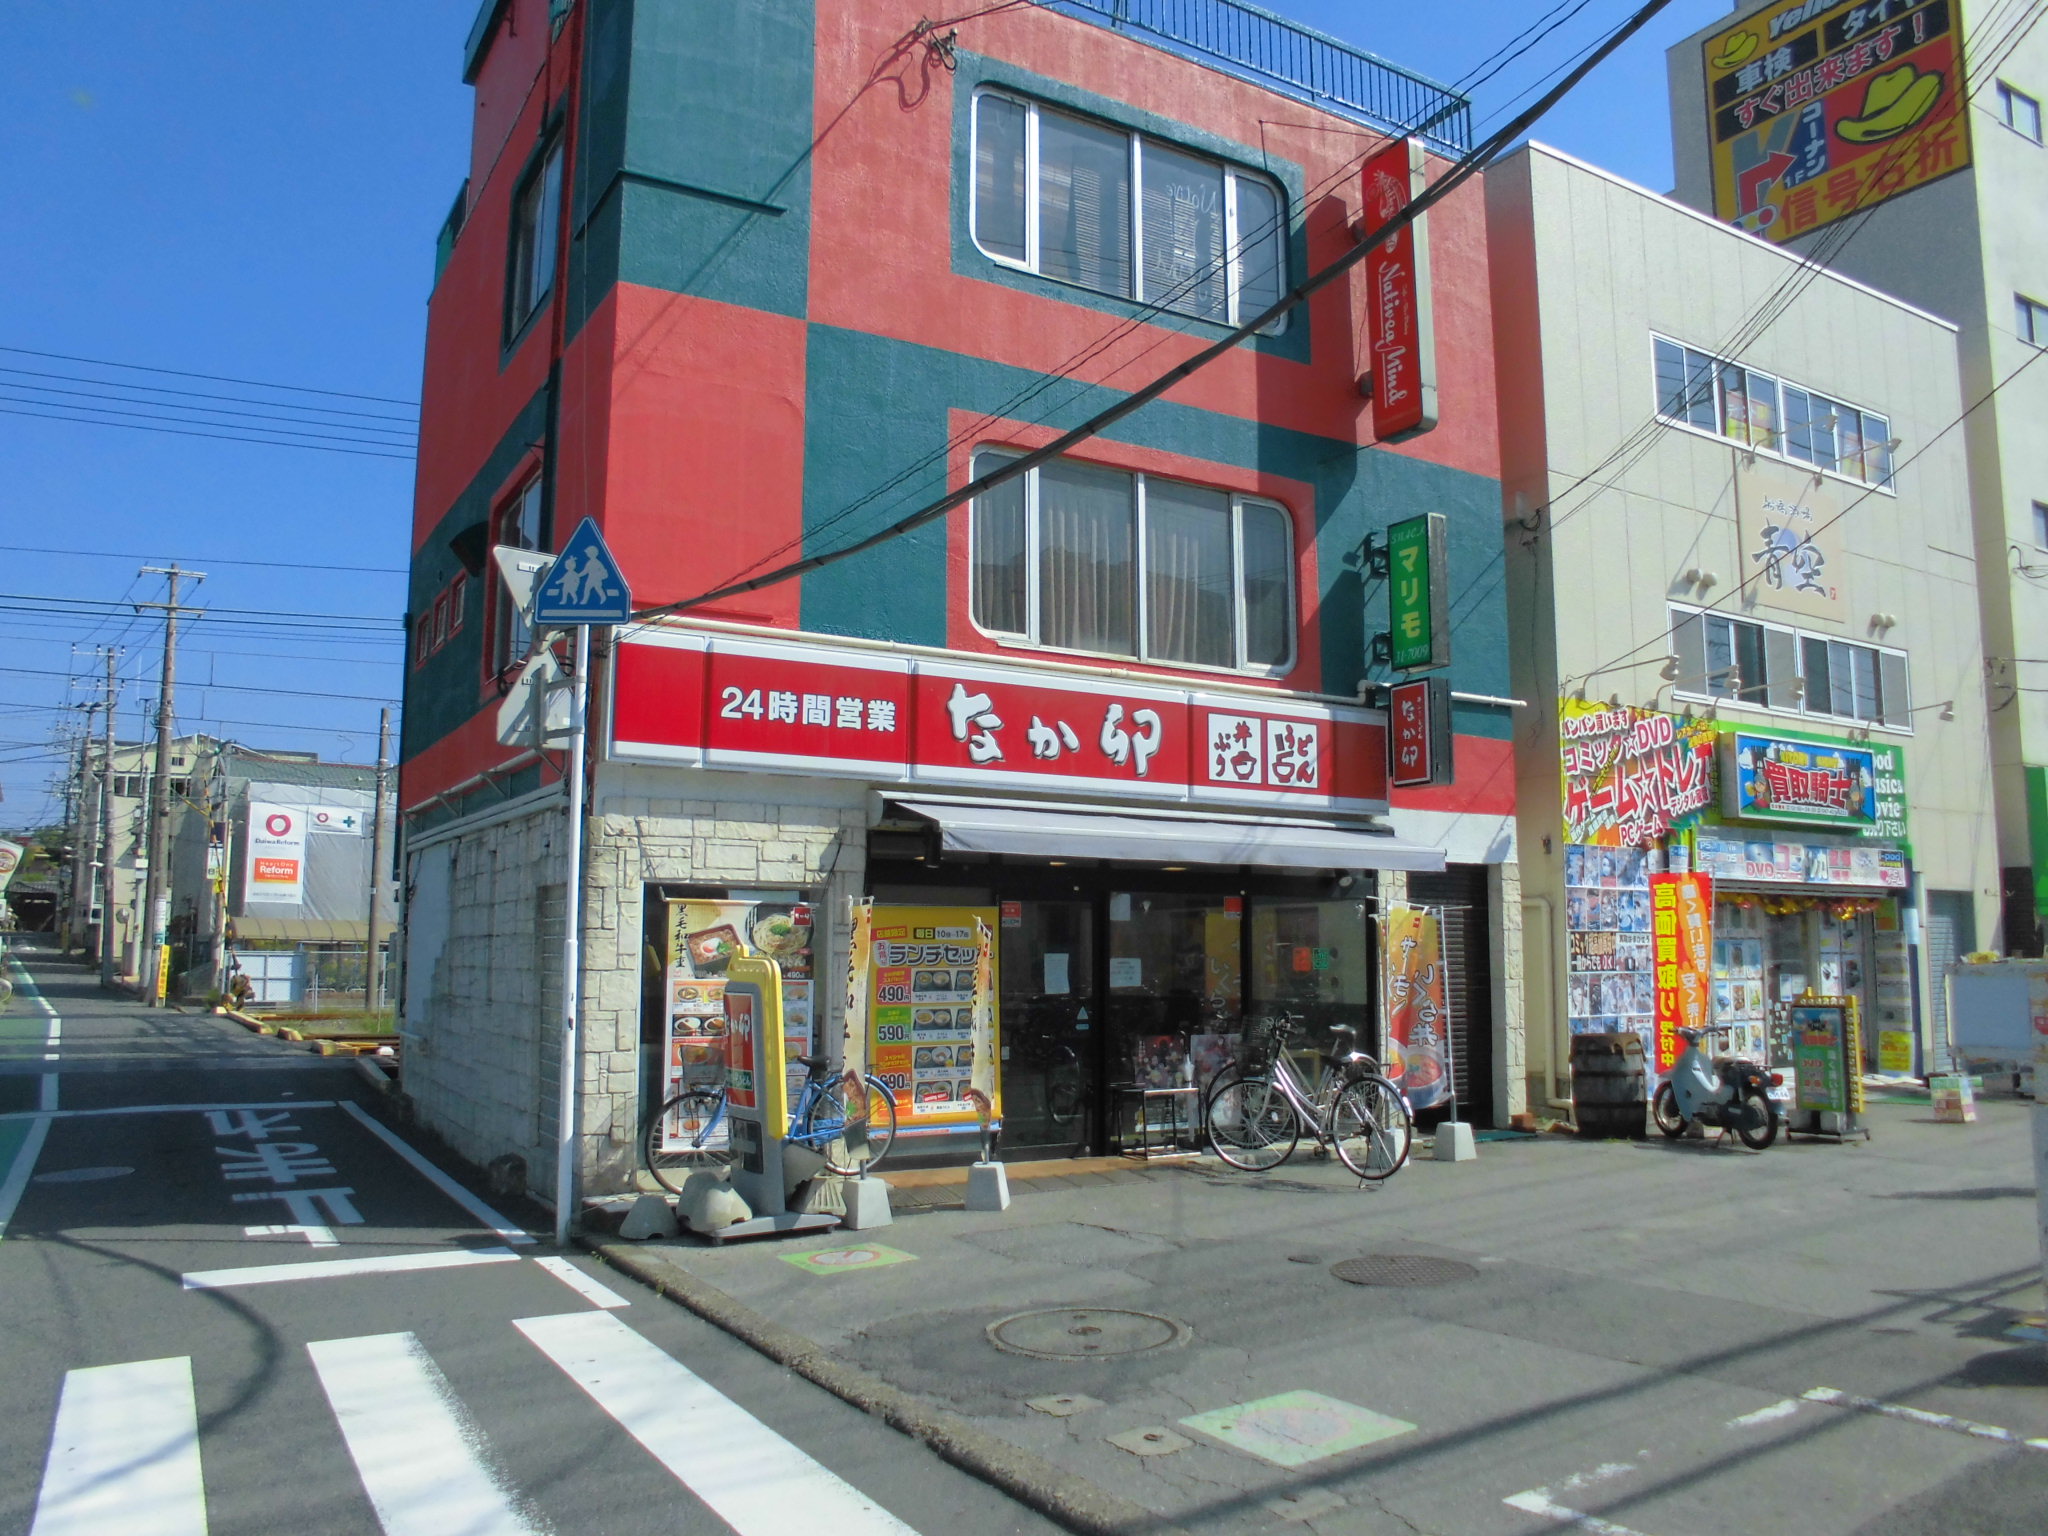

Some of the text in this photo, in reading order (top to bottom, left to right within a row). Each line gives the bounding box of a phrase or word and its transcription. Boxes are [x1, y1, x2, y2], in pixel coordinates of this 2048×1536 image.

[1736, 46, 1793, 95] 車検
[1802, 101, 1826, 178] コーナン
[1780, 131, 1959, 236] 信号右折
[1399, 545, 1421, 638] マリモ
[720, 685, 897, 733] 24時間営業
[946, 682, 1164, 778] なか卯
[1401, 700, 1419, 768] なか卯
[1763, 757, 1853, 809] 買取騎士
[260, 866, 294, 875] Reform
[1746, 861, 1775, 878] DVD
[889, 943, 994, 967] ランチセッ
